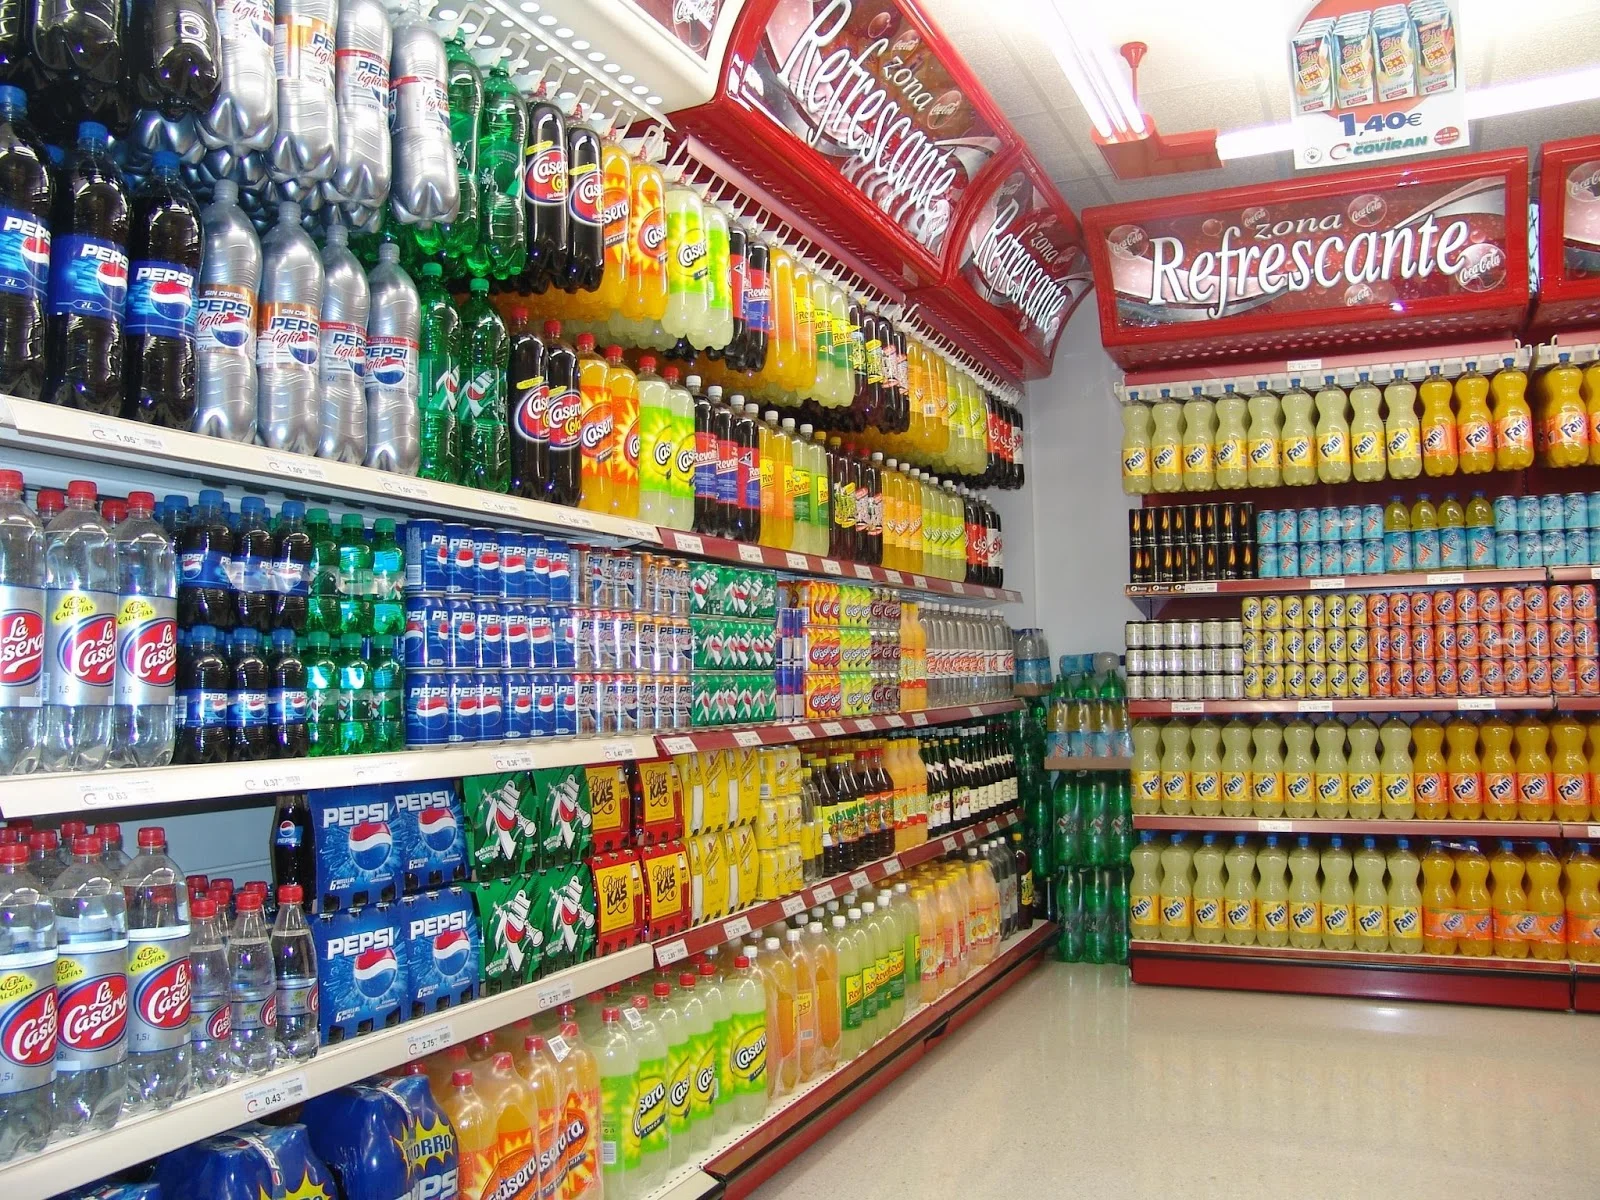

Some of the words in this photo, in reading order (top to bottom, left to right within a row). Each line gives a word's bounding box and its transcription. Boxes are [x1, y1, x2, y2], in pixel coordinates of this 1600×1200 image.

[232, 3, 259, 20] ligh
[314, 47, 335, 65] ligh
[882, 52, 936, 113] zona
[777, 0, 959, 215] Refrescante
[1339, 112, 1423, 137] 1,40€
[579, 179, 603, 203] Cas
[4, 215, 51, 243] PEPS
[645, 225, 667, 249] Cas
[1255, 213, 1343, 242] zona
[81, 243, 128, 270] PEPS
[678, 239, 707, 267] Caser
[1029, 229, 1058, 264] zona
[136, 267, 195, 289] PEPSI
[972, 200, 1067, 329] Refrescante
[1149, 211, 1469, 322] Refrescante
[366, 357, 386, 373] ight
[528, 392, 549, 420] Cas
[582, 416, 613, 449] Caser
[449, 539, 474, 549] PEP
[527, 547, 549, 557] PEP
[181, 553, 205, 563] EPSI
[3, 616, 29, 645] La
[453, 612, 475, 623] PEP
[477, 614, 501, 625] PEP
[72, 640, 117, 678] Caser
[138, 644, 177, 678] Caser
[204, 692, 229, 703] PEPS
[282, 692, 308, 702] PEPS
[411, 687, 448, 698] PEPS
[451, 687, 477, 698] PEP
[511, 687, 531, 696] PEP
[534, 686, 555, 695] PEP
[395, 791, 451, 818] PEPSI
[592, 785, 615, 807] KAS
[649, 783, 669, 802] KAS
[323, 801, 390, 830] PEPSI
[606, 887, 628, 909] KAS
[657, 878, 676, 896] KAS
[410, 911, 468, 946] PEPSI
[327, 927, 395, 965] PEPSI
[92, 981, 113, 1011] La
[147, 980, 191, 1027] Caser
[62, 990, 127, 1045] Casera
[12, 1010, 57, 1061] Case
[670, 1074, 690, 1106] Cas
[697, 1063, 715, 1093] Cas
